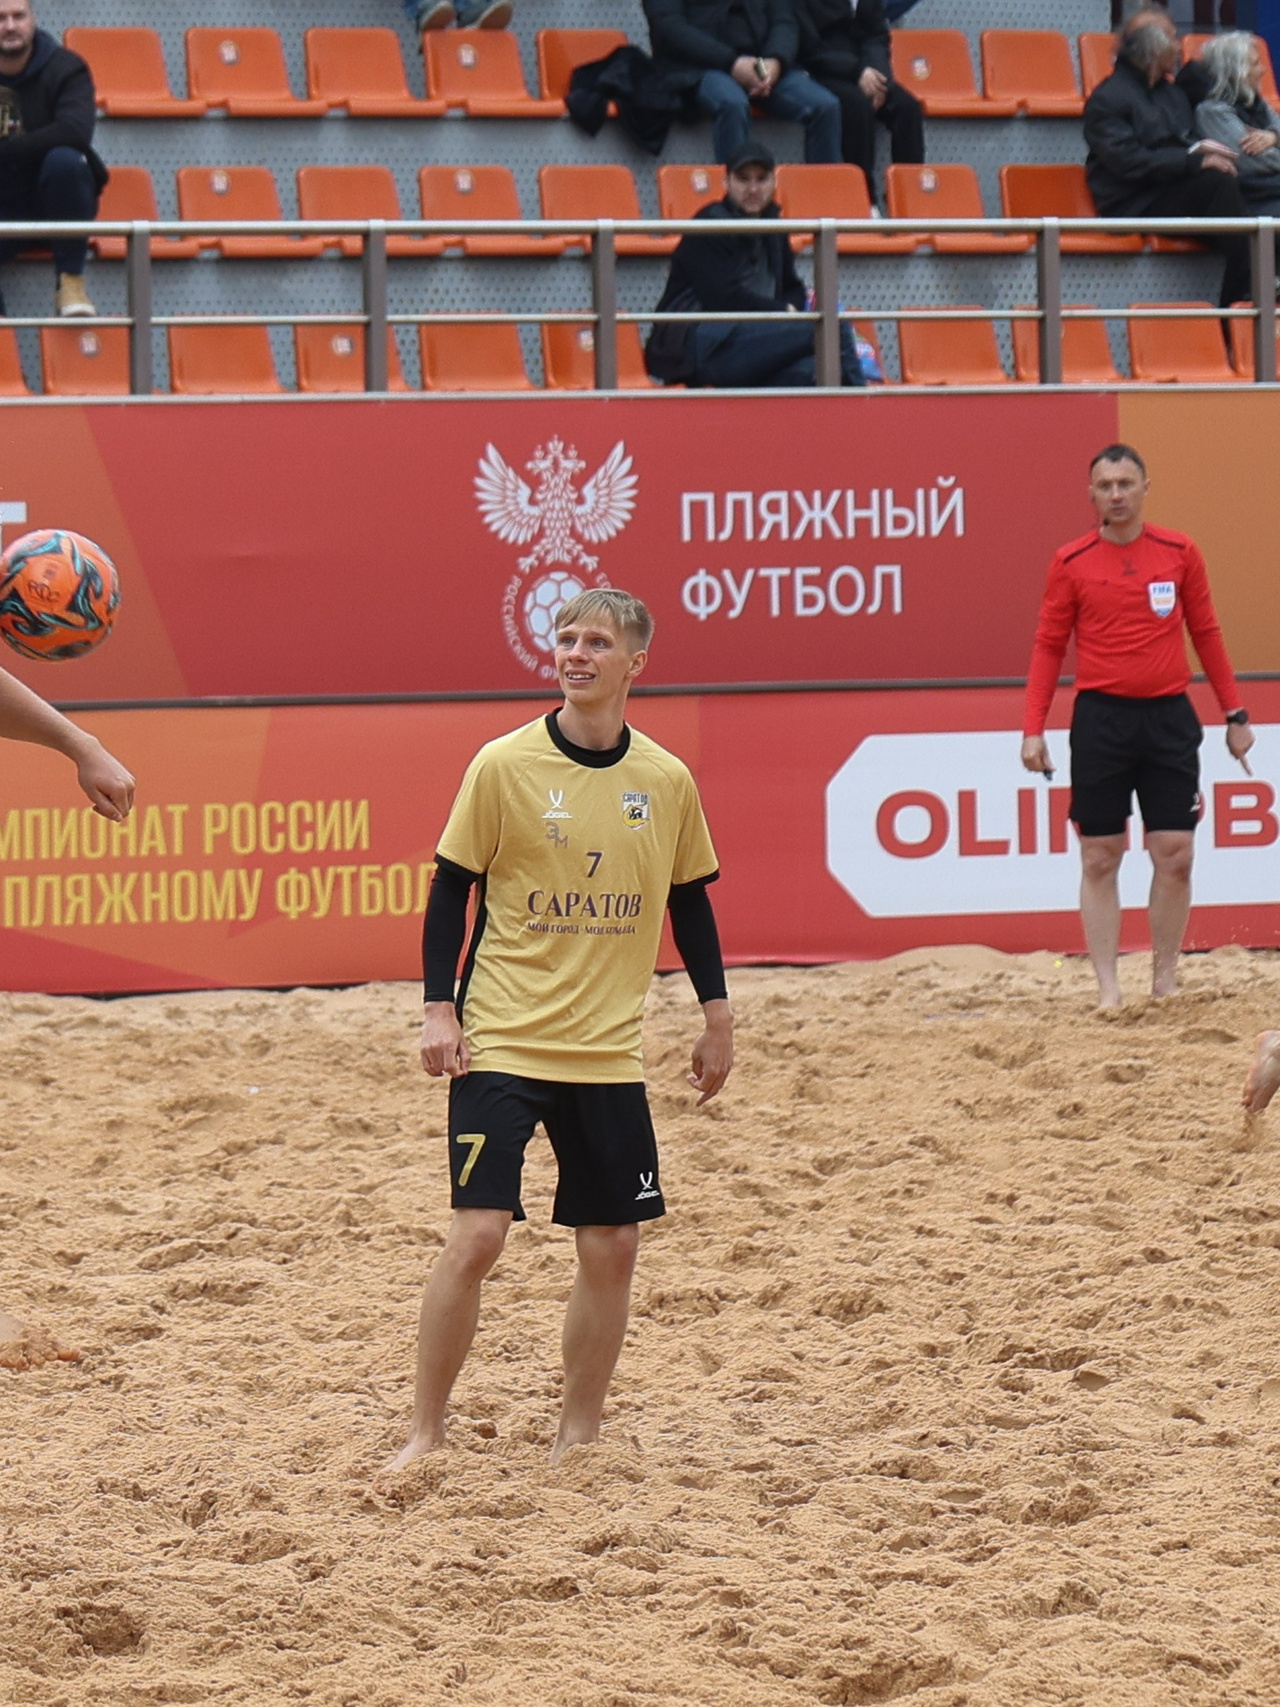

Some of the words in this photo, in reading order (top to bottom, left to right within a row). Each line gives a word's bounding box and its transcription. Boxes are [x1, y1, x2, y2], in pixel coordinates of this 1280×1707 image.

[680, 475, 965, 542] ПЛЯЖНЫЙ
[681, 563, 904, 621] ФУТБОЛ
[201, 798, 371, 855] РОССИИ
[586, 851, 603, 878] 7
[3, 867, 263, 929] ПЛЯЖНОМУ
[275, 861, 438, 920] ФУТБОЛ
[526, 889, 642, 919] САРАТОВ
[456, 1133, 487, 1187] 7
